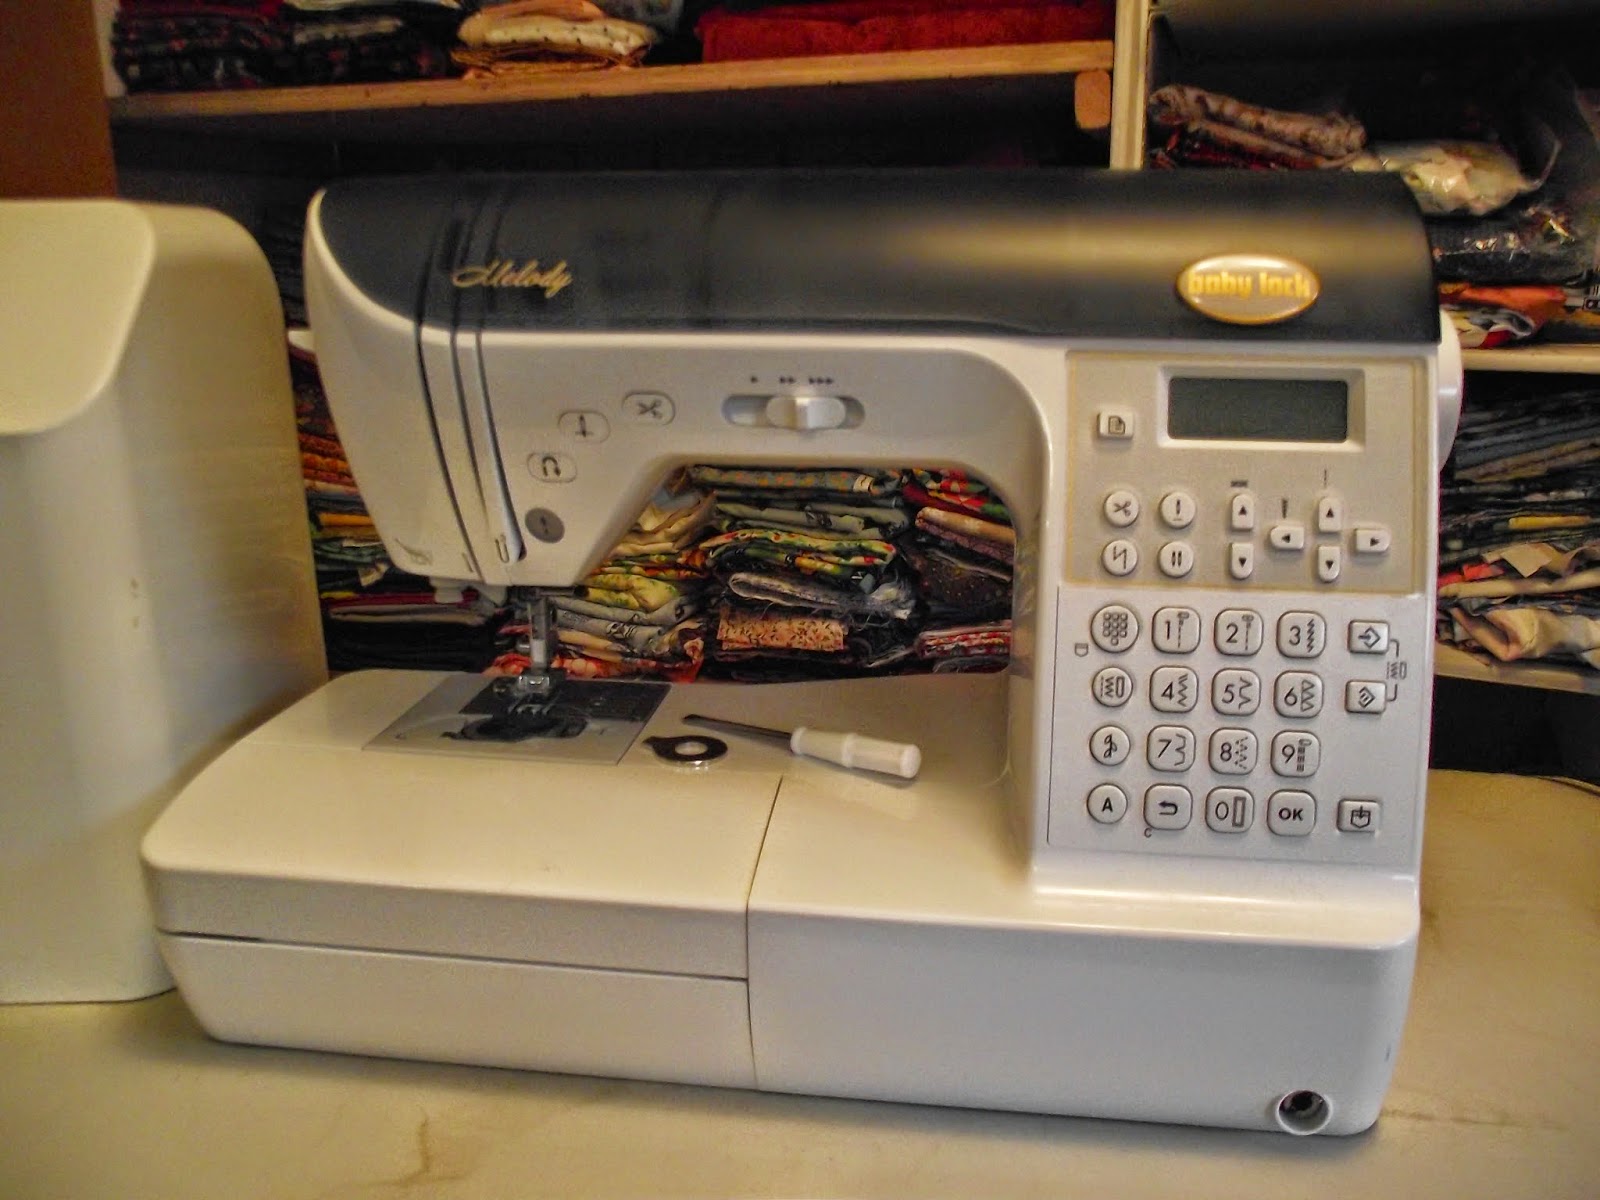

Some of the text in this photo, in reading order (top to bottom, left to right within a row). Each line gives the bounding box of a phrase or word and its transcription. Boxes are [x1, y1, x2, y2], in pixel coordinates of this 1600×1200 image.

[1164, 619, 1172, 641] 1
[1225, 622, 1240, 644] 2
[1288, 625, 1302, 647] 3
[1160, 681, 1175, 701] 4
[1220, 683, 1236, 705] 5
[1283, 686, 1299, 707] 6
[1157, 738, 1173, 759] 7
[1219, 742, 1233, 763] 8
[1282, 744, 1296, 764] 9
[1101, 796, 1114, 813] A
[1277, 807, 1305, 823] OK
